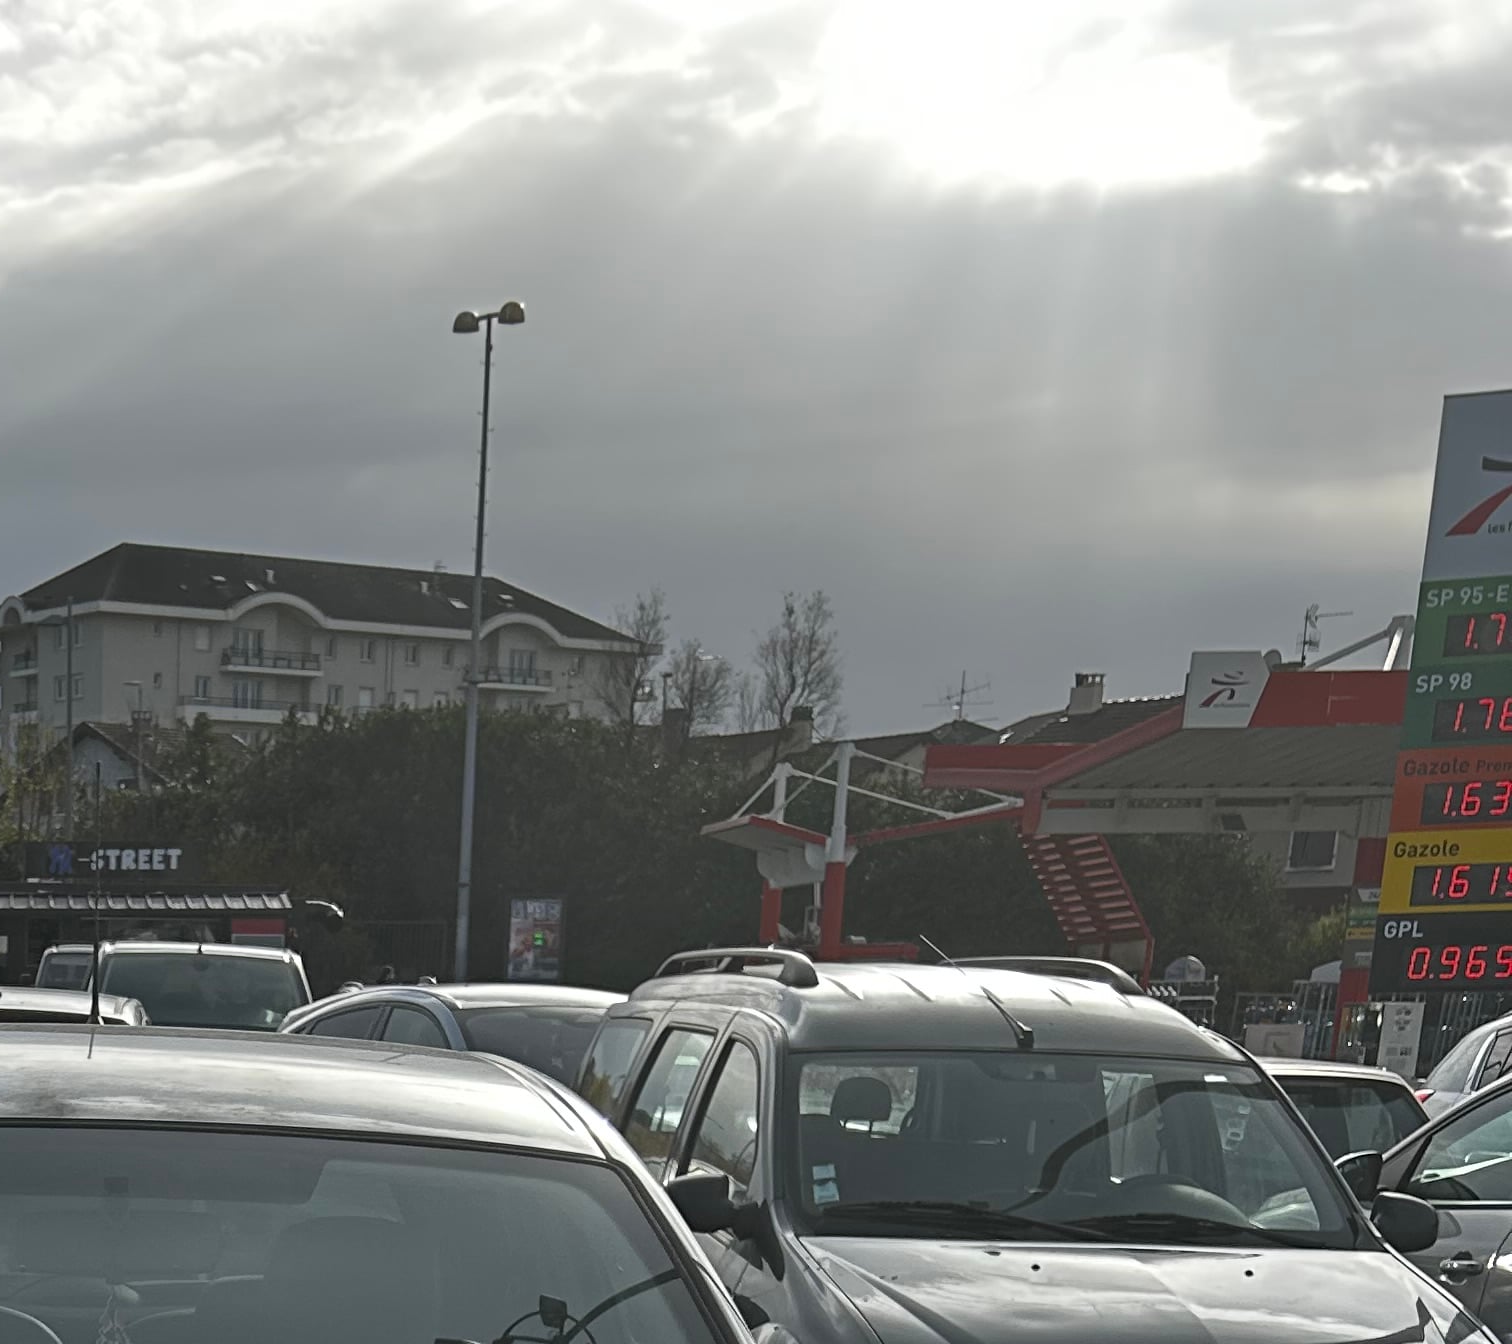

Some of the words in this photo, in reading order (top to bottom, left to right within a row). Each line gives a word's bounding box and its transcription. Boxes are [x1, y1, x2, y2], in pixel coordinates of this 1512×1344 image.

[1426, 588, 1454, 608] SP
[1416, 674, 1443, 693] SP
[1449, 672, 1472, 692] 98
[1403, 757, 1469, 777] Gazole
[1394, 840, 1460, 859] Gazole
[1384, 920, 1423, 938] GPL
